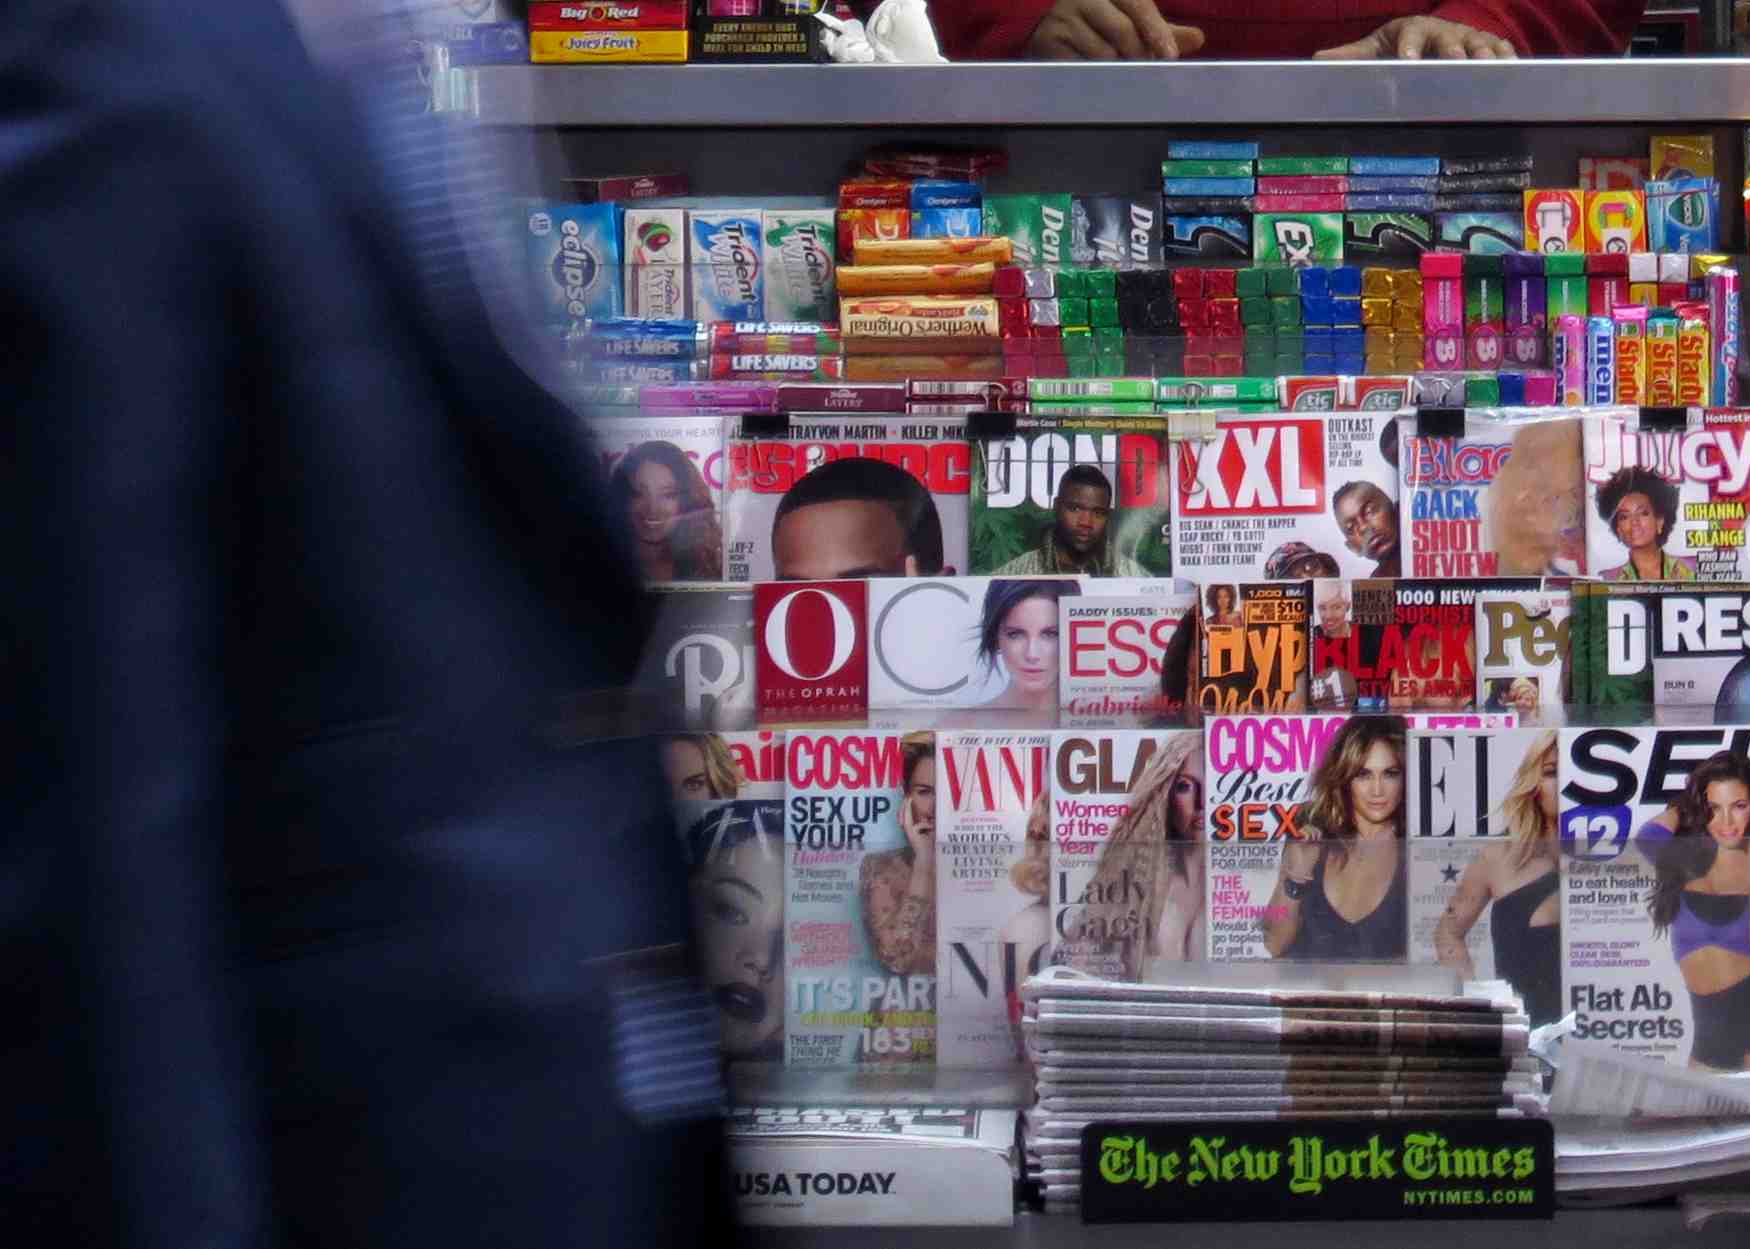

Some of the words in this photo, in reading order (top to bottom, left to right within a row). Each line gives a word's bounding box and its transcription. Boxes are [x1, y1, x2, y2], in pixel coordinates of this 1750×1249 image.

[560, 6, 588, 20] Big
[608, 6, 640, 18] Red
[568, 37, 600, 50] Juicy
[602, 36, 635, 49] Fruit
[560, 220, 586, 317] eclipse
[725, 224, 757, 302] Trident
[732, 356, 762, 371] LIFE
[764, 355, 817, 370] SAVERS
[790, 425, 840, 440] TRAYVON
[844, 425, 887, 439] MARTIN
[902, 425, 939, 439] KILLER
[1328, 419, 1373, 432] OUTKAST
[1185, 426, 1316, 509] XXL
[1411, 489, 1479, 520] BACK
[1685, 503, 1745, 521] RIHANNA
[1412, 520, 1480, 553] SHOT
[1687, 530, 1745, 547] SOLANGE
[1413, 553, 1499, 577] REVIEW
[1396, 590, 1434, 606] 1000
[1440, 591, 1474, 605] NEW
[800, 686, 862, 699] OPRAH
[1209, 767, 1303, 804] Best
[791, 796, 847, 824] SEX
[853, 796, 891, 823] UP
[1056, 800, 1130, 818] Women
[1055, 820, 1077, 837] of
[1080, 820, 1109, 837] the
[1212, 804, 1301, 844] SEX
[791, 825, 865, 851] YOUR
[1568, 815, 1620, 855] 12
[1058, 838, 1099, 854] Year
[1569, 878, 1583, 889] to
[1586, 878, 1608, 889] eat
[1569, 893, 1596, 904] and
[1598, 892, 1626, 904] love
[1628, 892, 1638, 904] it
[1570, 984, 1625, 1012] Flat
[1630, 985, 1672, 1010] Ab
[1570, 1014, 1684, 1040] Secrets
[1100, 1136, 1180, 1189] The
[1188, 1135, 1279, 1187] New
[1289, 1135, 1397, 1195] York
[1403, 1132, 1535, 1181] Times
[735, 1172, 792, 1196] USA
[795, 1171, 893, 1197] TODAY
[1404, 1189, 1535, 1204] NYTIMES.COM
